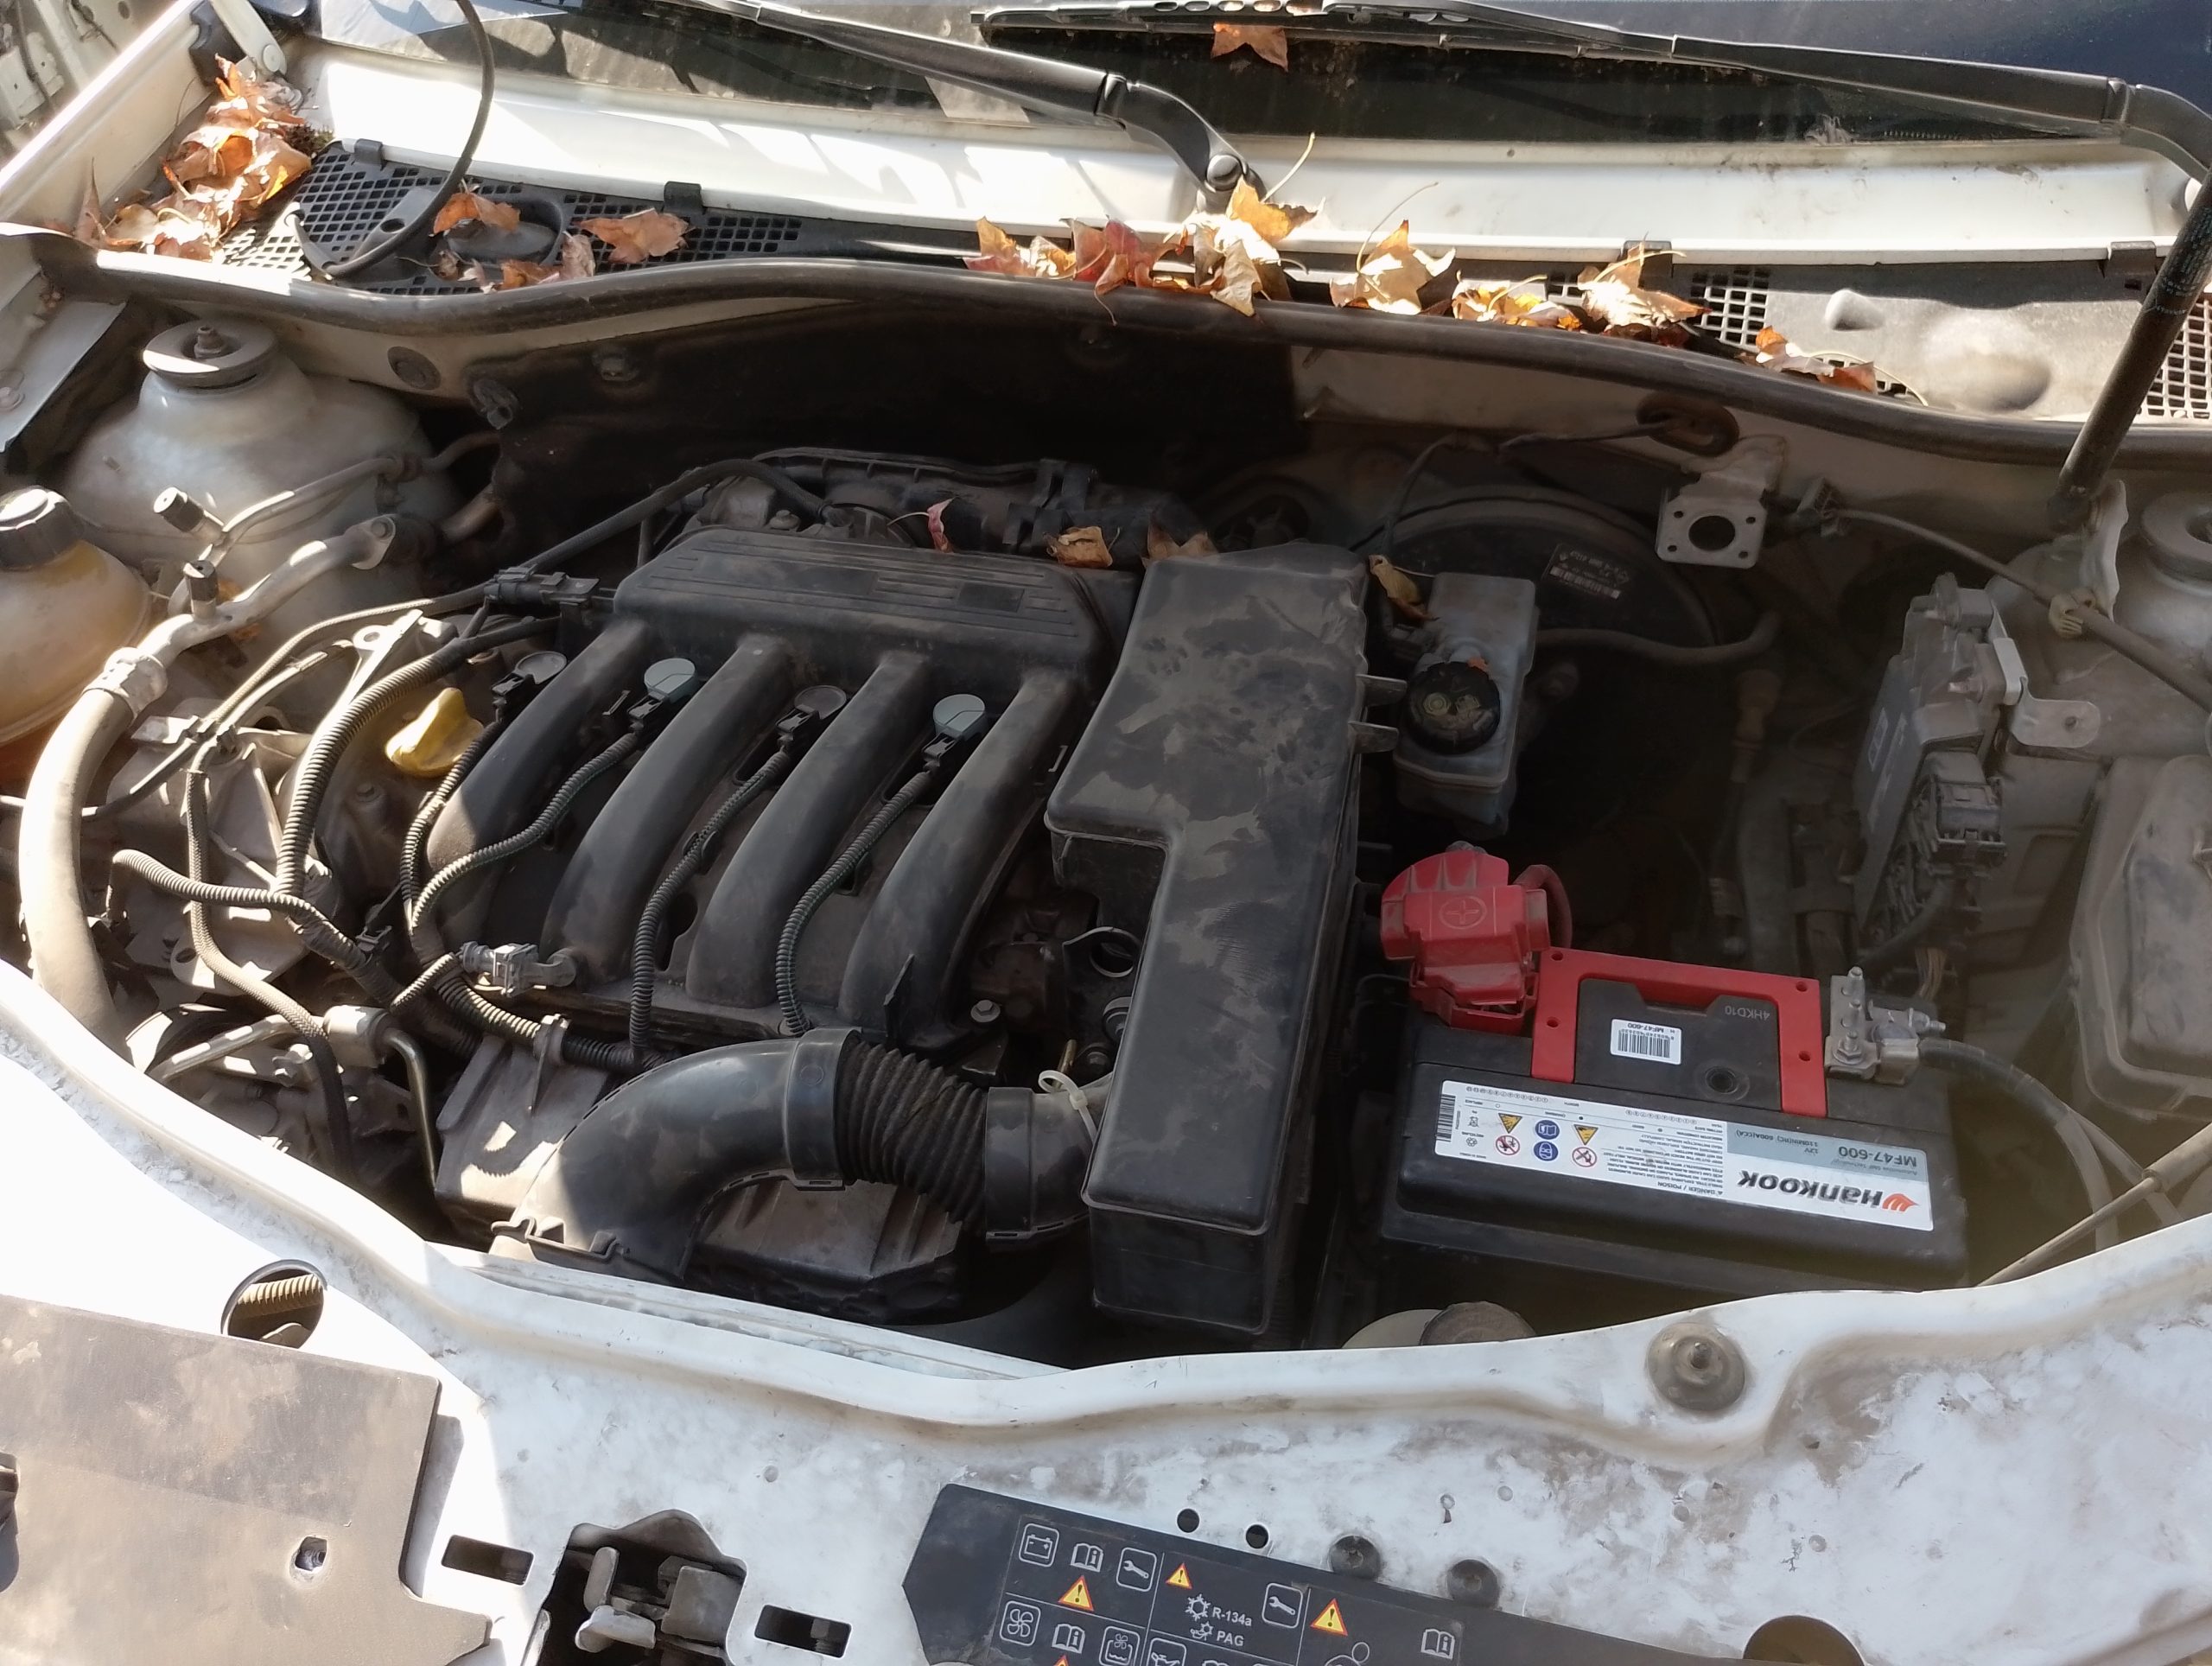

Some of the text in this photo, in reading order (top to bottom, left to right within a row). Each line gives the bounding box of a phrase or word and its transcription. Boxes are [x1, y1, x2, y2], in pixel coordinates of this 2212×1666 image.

[1724, 1005, 1770, 1021] 4HKD10
[1627, 1022, 1663, 1032] MF47-600
[1837, 1146, 1917, 1167] MF47-600
[1657, 1180, 1681, 1189] POISON
[1688, 1186, 1715, 1194] DANGER
[1212, 1606, 1252, 1626] R-134a
[1216, 1630, 1244, 1647] PAG
